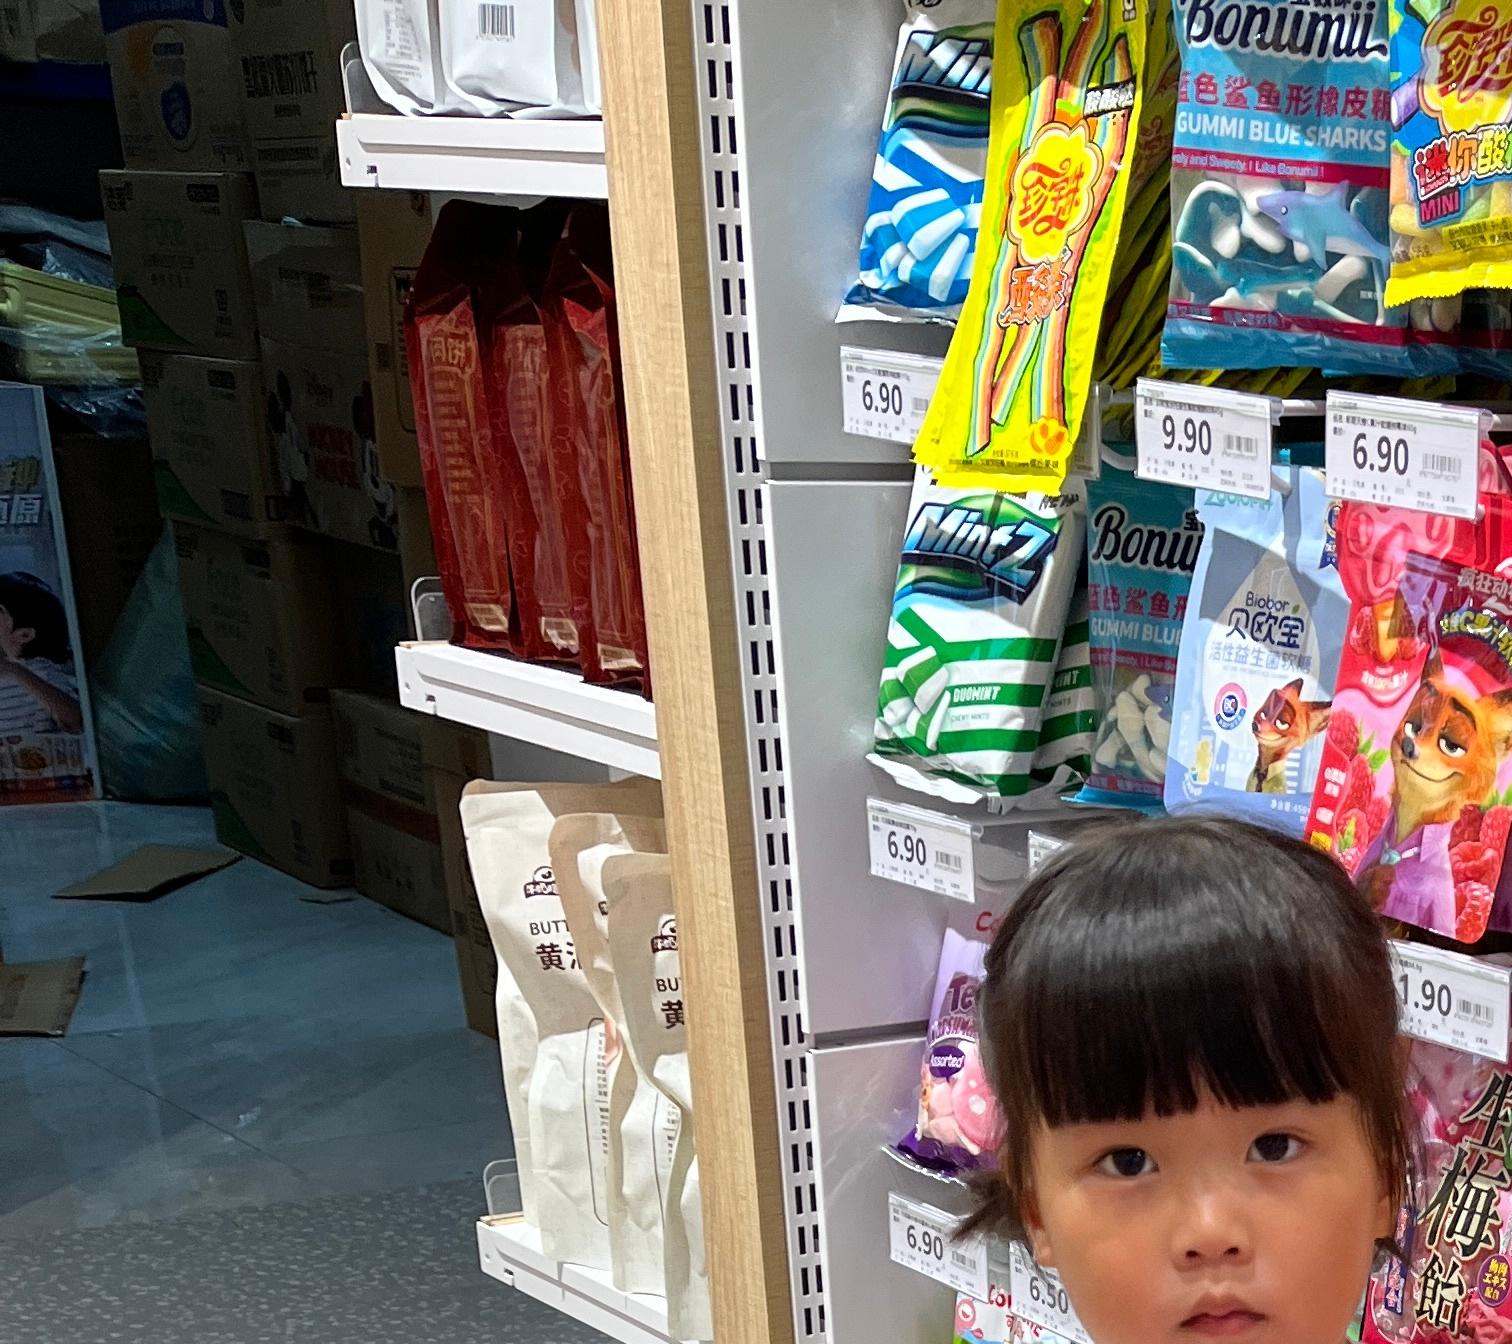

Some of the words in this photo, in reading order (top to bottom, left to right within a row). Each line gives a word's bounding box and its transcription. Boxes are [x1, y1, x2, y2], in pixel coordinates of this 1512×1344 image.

[1177, 111, 1245, 139] GUMMI
[1249, 119, 1301, 145] BLUE
[1304, 125, 1387, 152] SHARKS
[1421, 191, 1459, 221] MINI
[861, 378, 903, 417] 6.90
[1162, 414, 1212, 456] 9.90
[1352, 433, 1409, 476] 6.90
[1245, 591, 1290, 611] Biobor
[1090, 619, 1139, 640] GUMMI
[1227, 607, 1305, 649] 贝欧宝
[886, 831, 927, 867] 6.90
[906, 1225, 944, 1261] 6.90
[1028, 1276, 1069, 1315] 6.50
